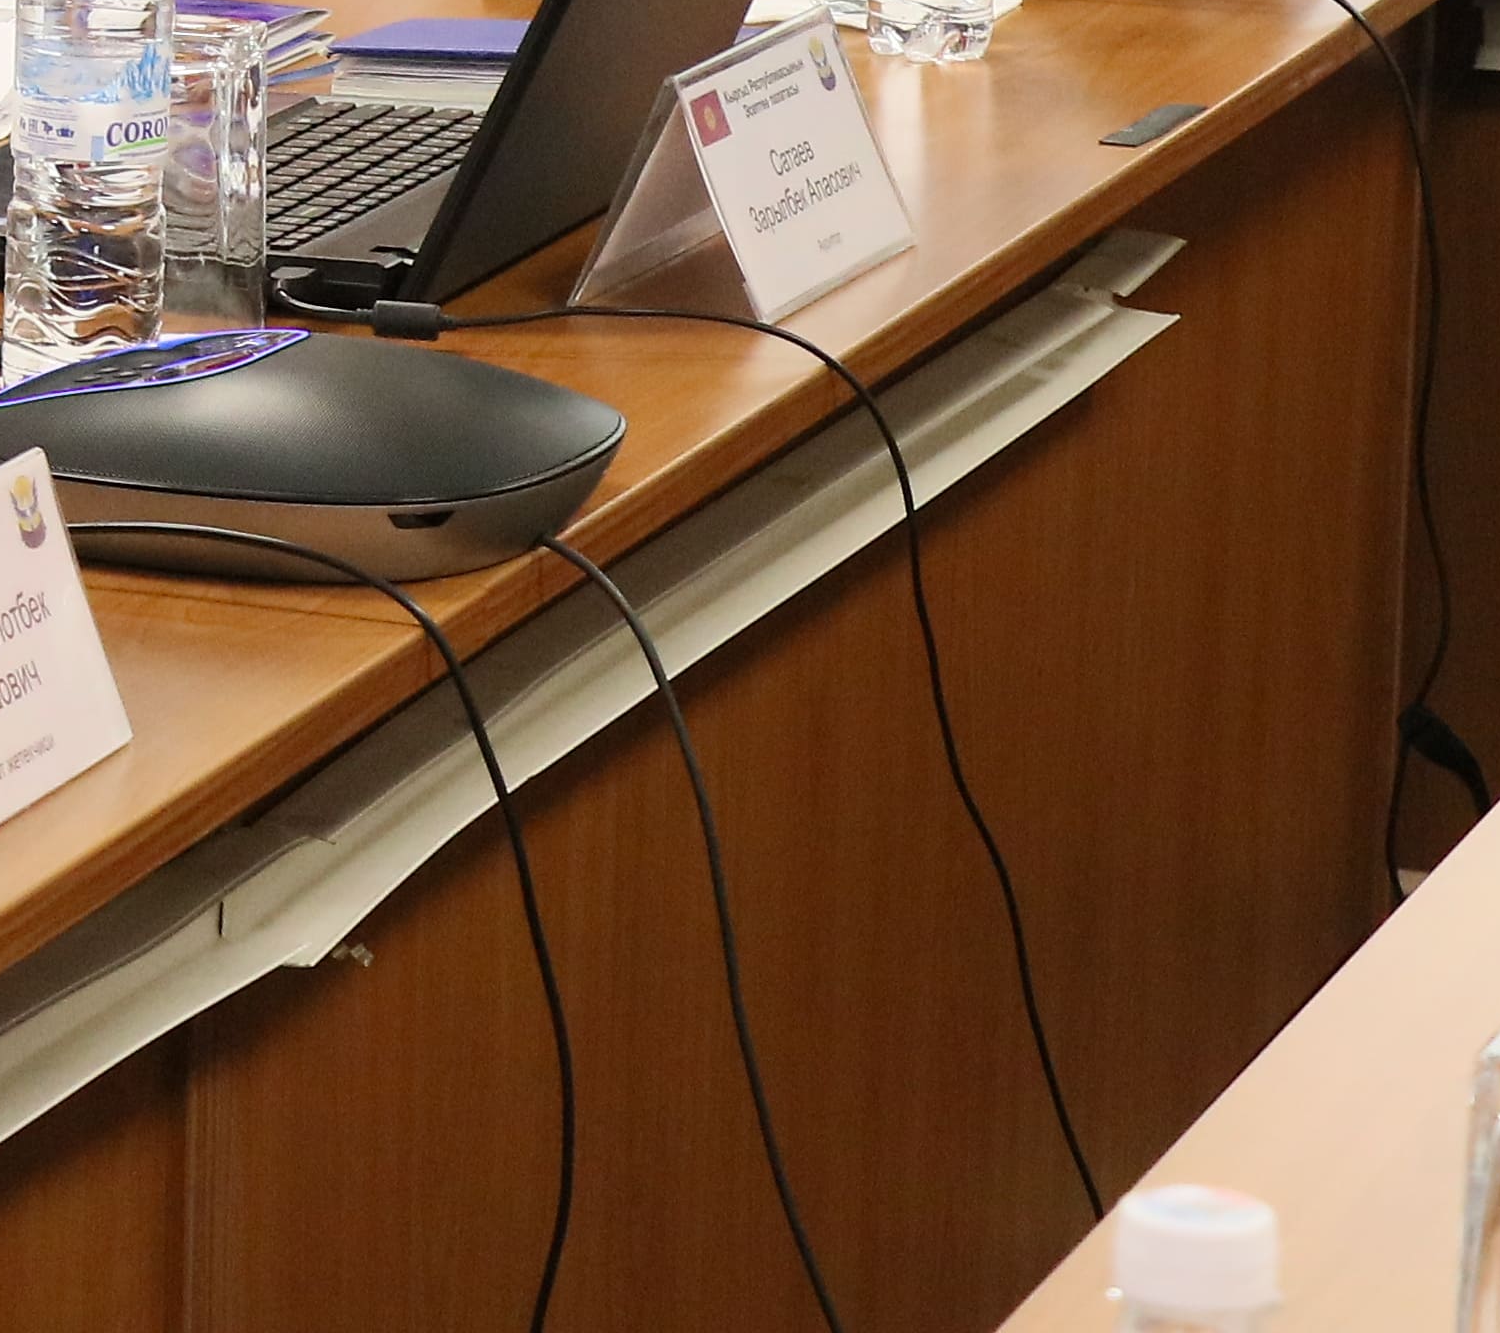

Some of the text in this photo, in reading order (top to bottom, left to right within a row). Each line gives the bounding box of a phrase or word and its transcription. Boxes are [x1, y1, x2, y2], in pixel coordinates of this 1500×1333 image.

[105, 116, 169, 147] CORO
[769, 139, 816, 176] Сатаев
[748, 186, 809, 235] Зарылбек
